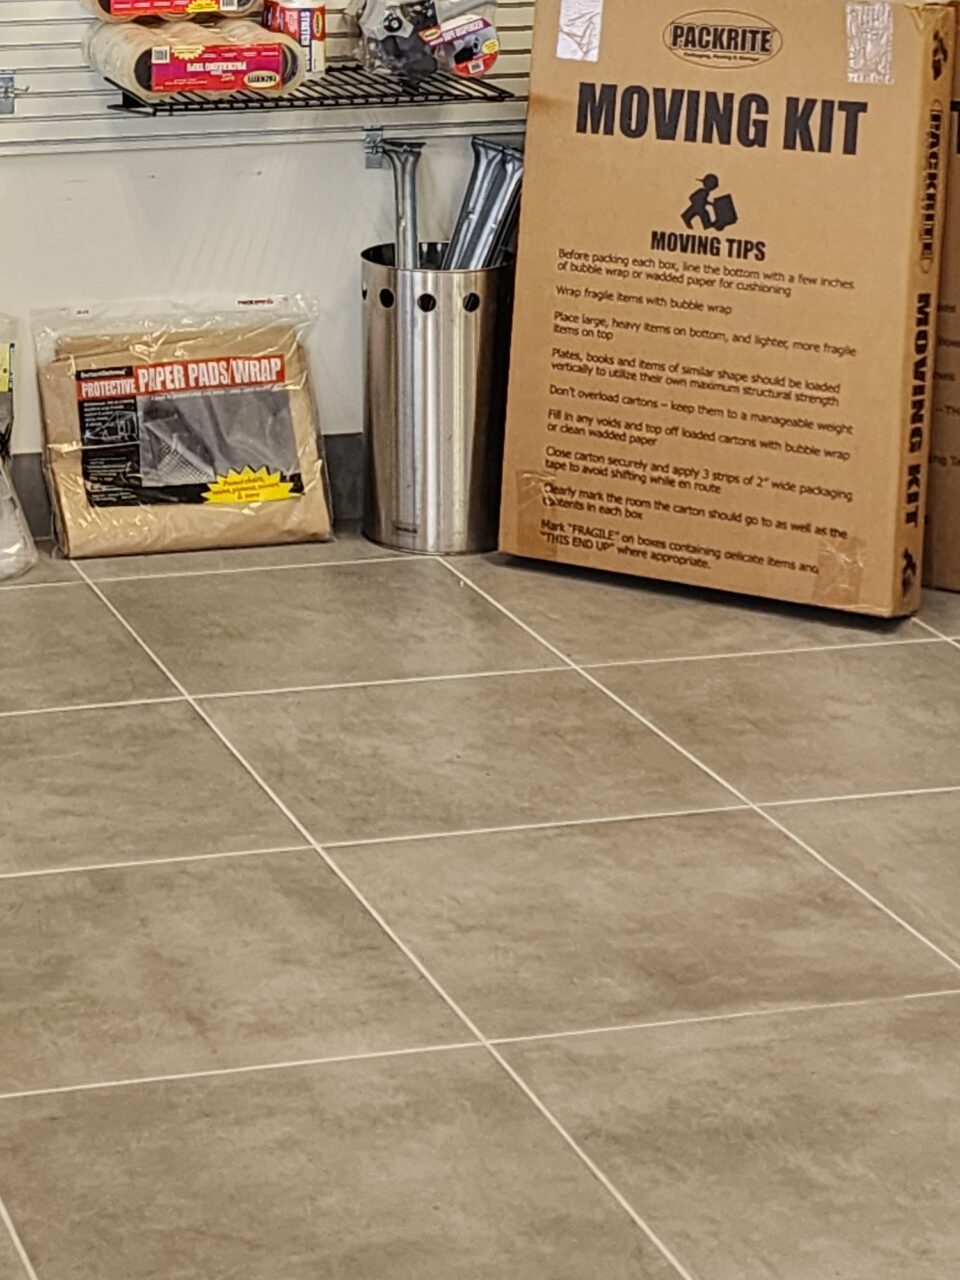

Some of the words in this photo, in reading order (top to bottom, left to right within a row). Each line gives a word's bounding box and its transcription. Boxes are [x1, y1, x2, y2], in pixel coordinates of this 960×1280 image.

[672, 25, 772, 52] PACKRITE
[576, 82, 769, 148] MOVING
[783, 97, 868, 156] KIT
[920, 112, 942, 261] PACKRITE
[651, 231, 721, 257] MOVING
[726, 237, 766, 262] TIPS
[558, 261, 568, 270] of
[570, 263, 602, 275] bubble
[606, 268, 629, 278] wrap
[632, 270, 642, 278] or
[646, 271, 684, 283] wadded
[687, 275, 716, 287] paper
[719, 278, 733, 288] for
[736, 281, 792, 297] cushioning
[559, 248, 589, 261] Before
[592, 253, 629, 267] packing
[632, 257, 655, 268] each
[683, 262, 700, 271] line
[704, 265, 720, 275] the
[724, 266, 760, 279] bottom
[763, 271, 785, 281] with
[798, 274, 817, 285] few
[556, 285, 581, 298] Wrap
[584, 288, 614, 301] fragile
[617, 291, 643, 304] items
[646, 296, 667, 307] with
[671, 298, 704, 312] bubble
[707, 303, 732, 315] wrap
[553, 324, 579, 336] items
[582, 328, 594, 337] on
[597, 329, 613, 340] top
[554, 311, 579, 323] Place
[612, 318, 640, 333] heavy
[644, 322, 670, 334] items
[673, 327, 686, 336] on
[732, 333, 751, 344] and
[793, 341, 820, 352] more
[824, 343, 857, 357] fragile
[81, 377, 137, 398] PROTECTIVE
[139, 366, 186, 393] PAPER
[189, 358, 281, 387] PADS/WRAP
[586, 352, 615, 365] books
[618, 357, 636, 368] and
[639, 360, 666, 371] items
[668, 362, 680, 372] of
[682, 365, 715, 378] similar
[718, 370, 748, 383] shape
[752, 375, 786, 388] should
[789, 378, 802, 389] be
[806, 381, 841, 393] loaded
[907, 292, 932, 453] MOVING
[577, 389, 619, 403] overload
[622, 396, 658, 408] cartons
[671, 401, 695, 415] keep
[698, 405, 723, 417] them
[728, 409, 737, 420] to
[741, 412, 747, 420] a
[751, 413, 814, 429] manageable
[817, 423, 853, 435] weight
[903, 464, 922, 528] KIT
[541, 519, 566, 533] Mark
[622, 534, 634, 543] on
[638, 535, 666, 549] boxes
[669, 541, 721, 560] containing
[572, 537, 593, 550] END
[617, 545, 648, 559] where
